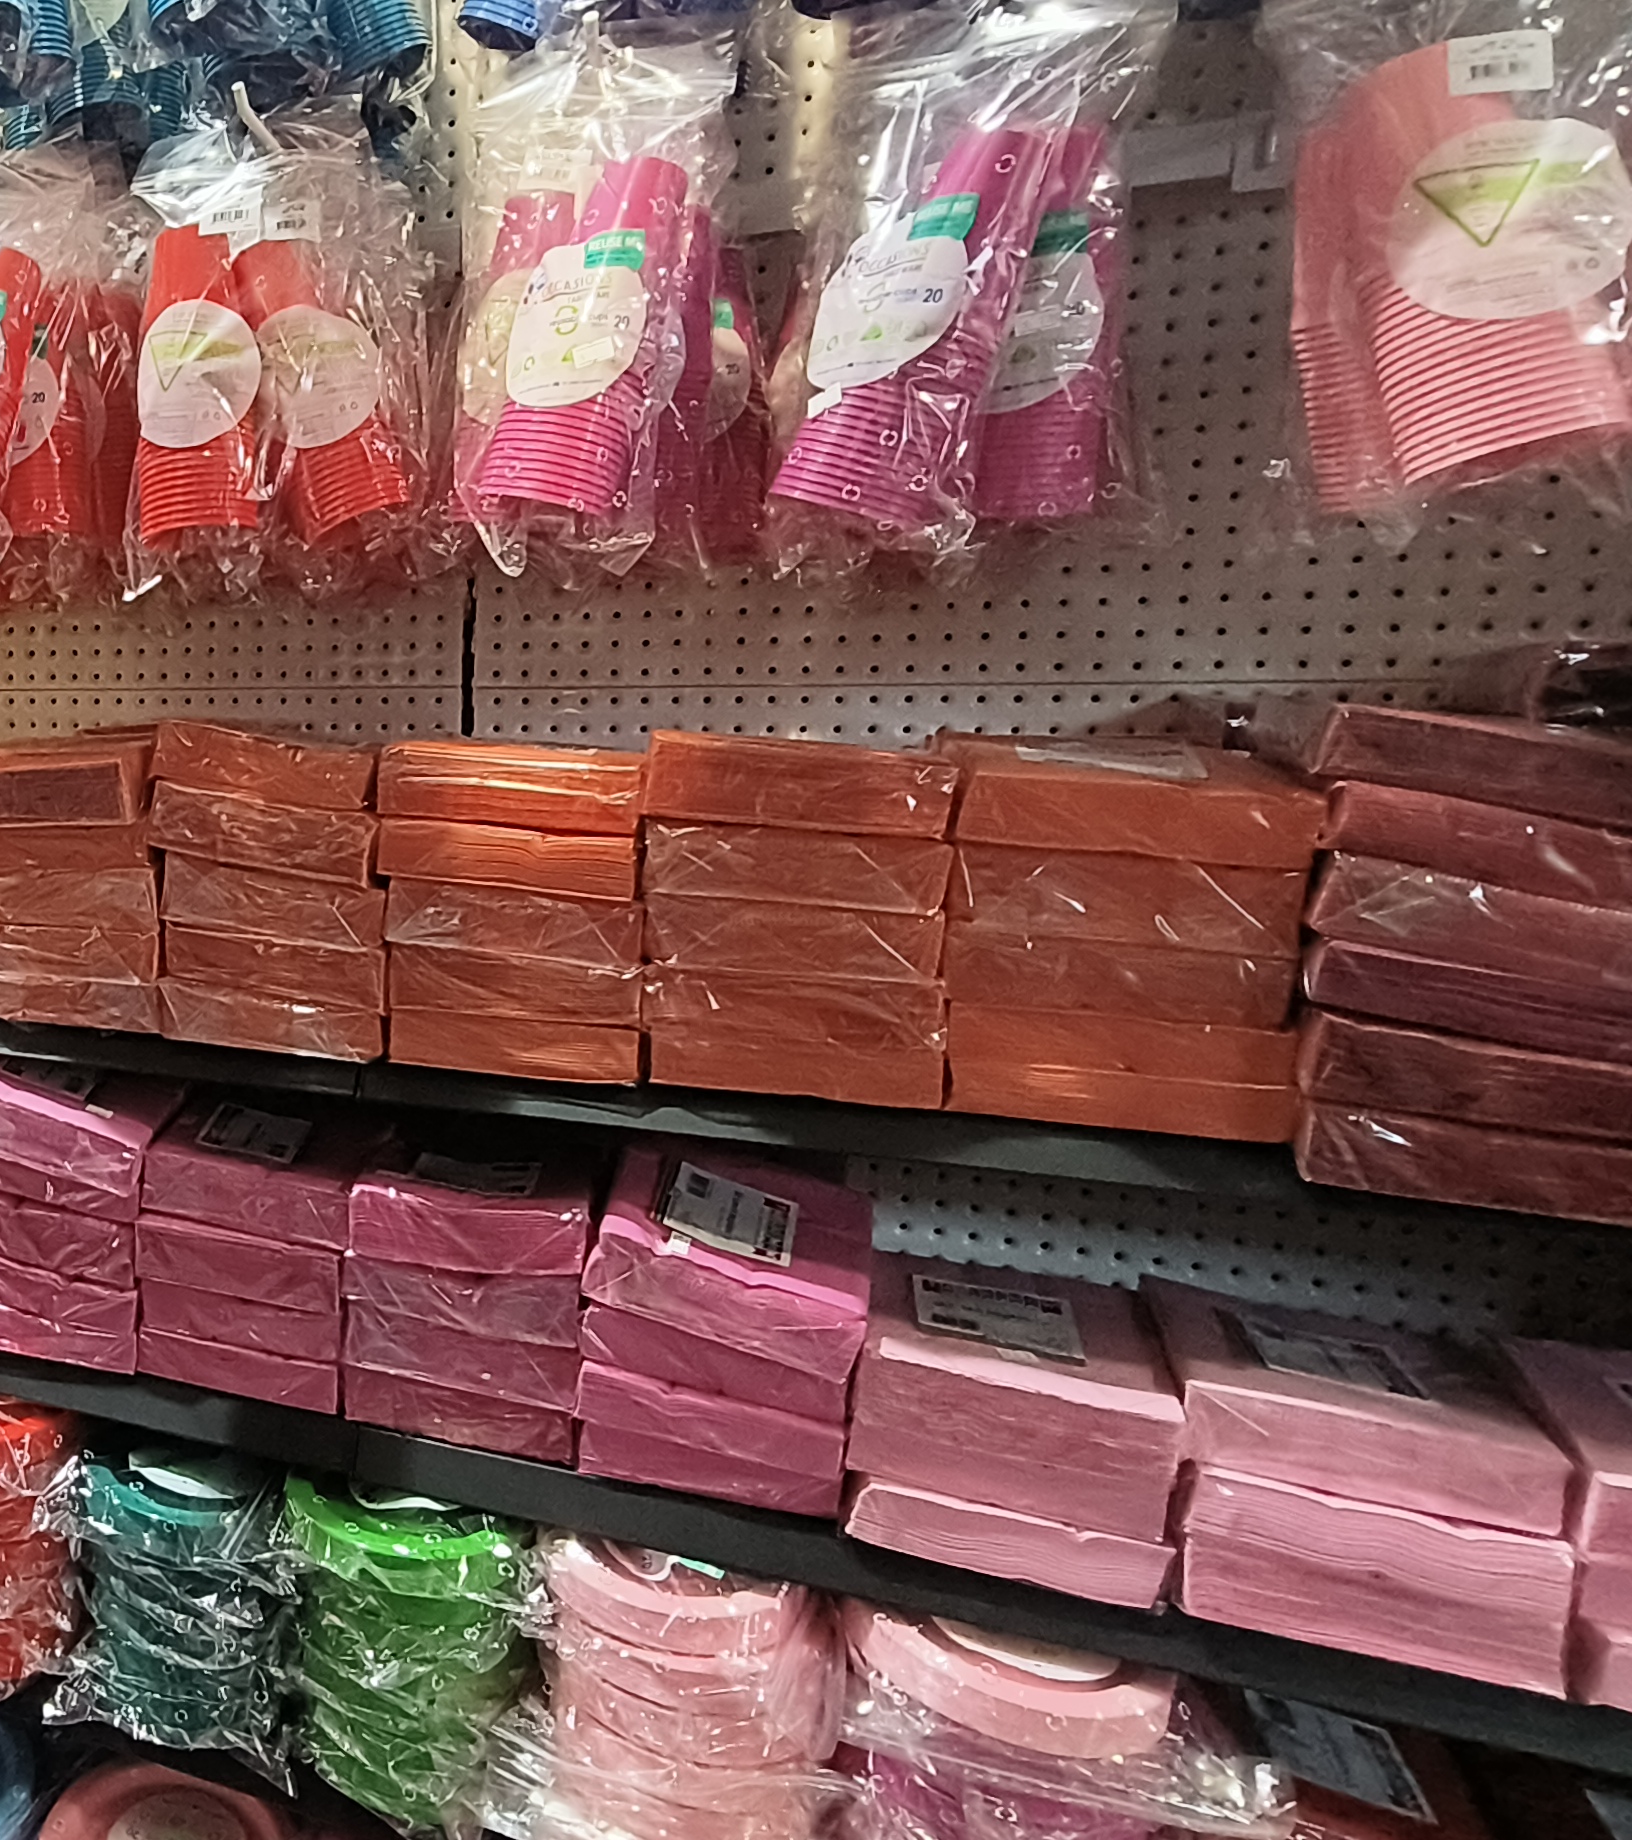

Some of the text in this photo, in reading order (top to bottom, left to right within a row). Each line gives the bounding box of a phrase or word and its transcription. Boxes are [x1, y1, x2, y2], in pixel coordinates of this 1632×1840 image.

[588, 236, 624, 251] REUSE
[922, 287, 944, 304] 20
[614, 314, 631, 330] 20
[31, 391, 46, 404] 20
